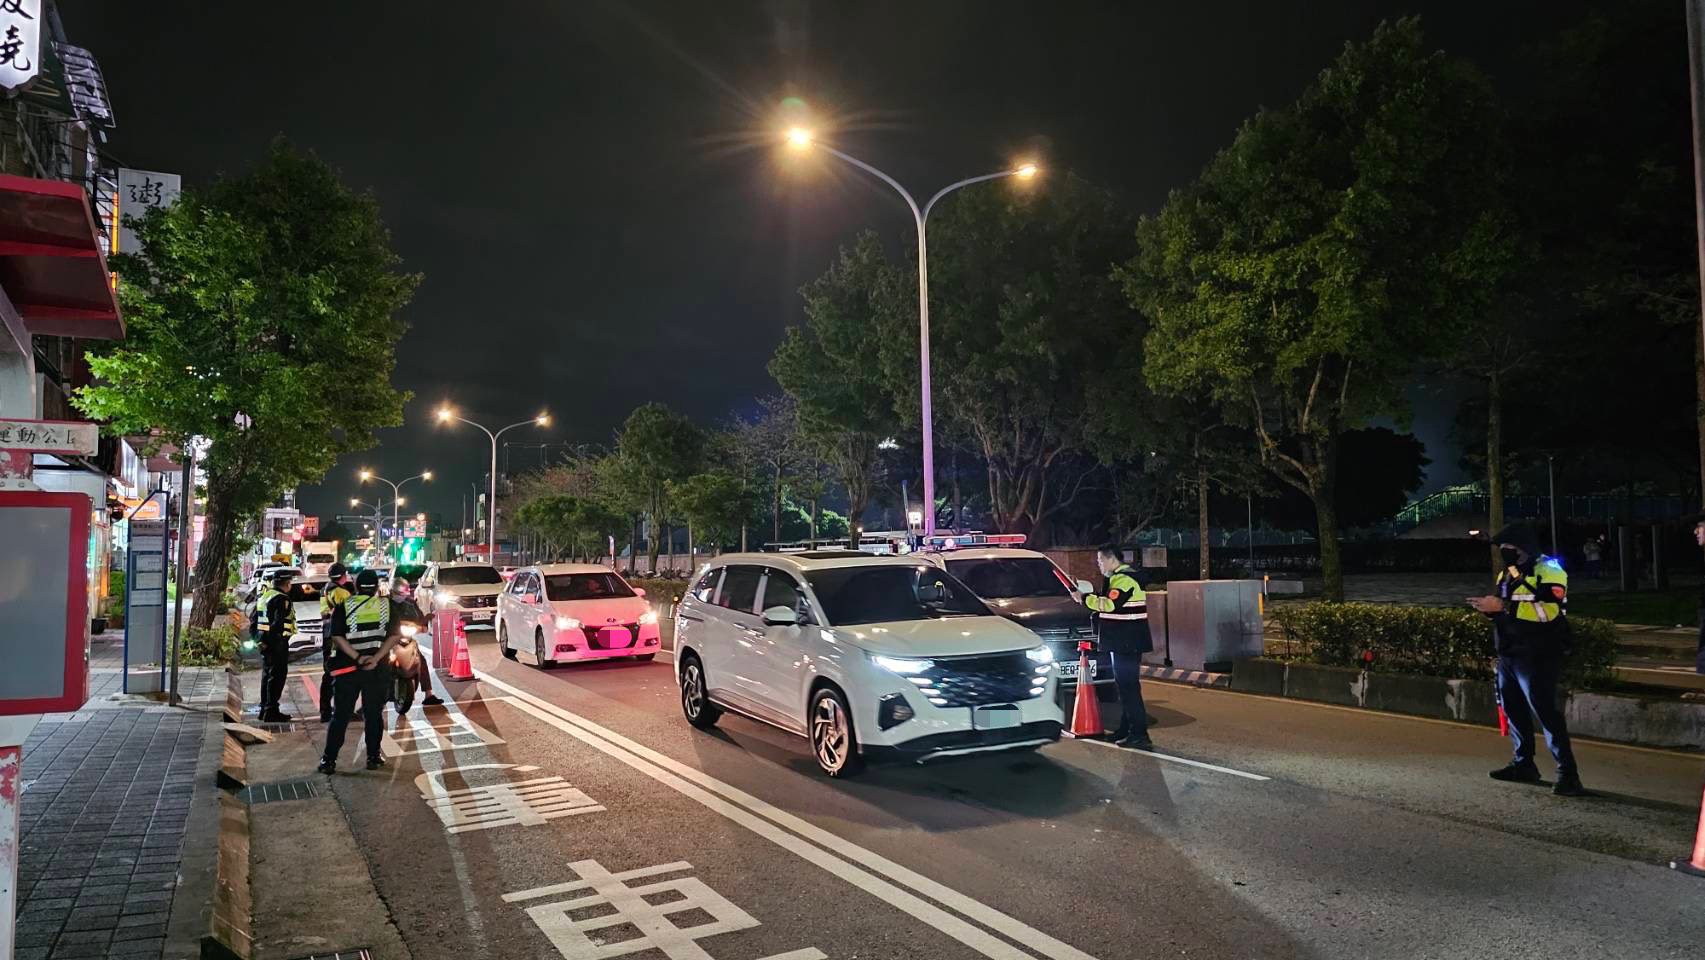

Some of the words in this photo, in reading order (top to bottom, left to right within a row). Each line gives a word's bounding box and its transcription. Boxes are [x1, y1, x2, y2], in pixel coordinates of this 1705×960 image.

[126, 176, 163, 205] 粥
[0, 426, 75, 445] 運動公
